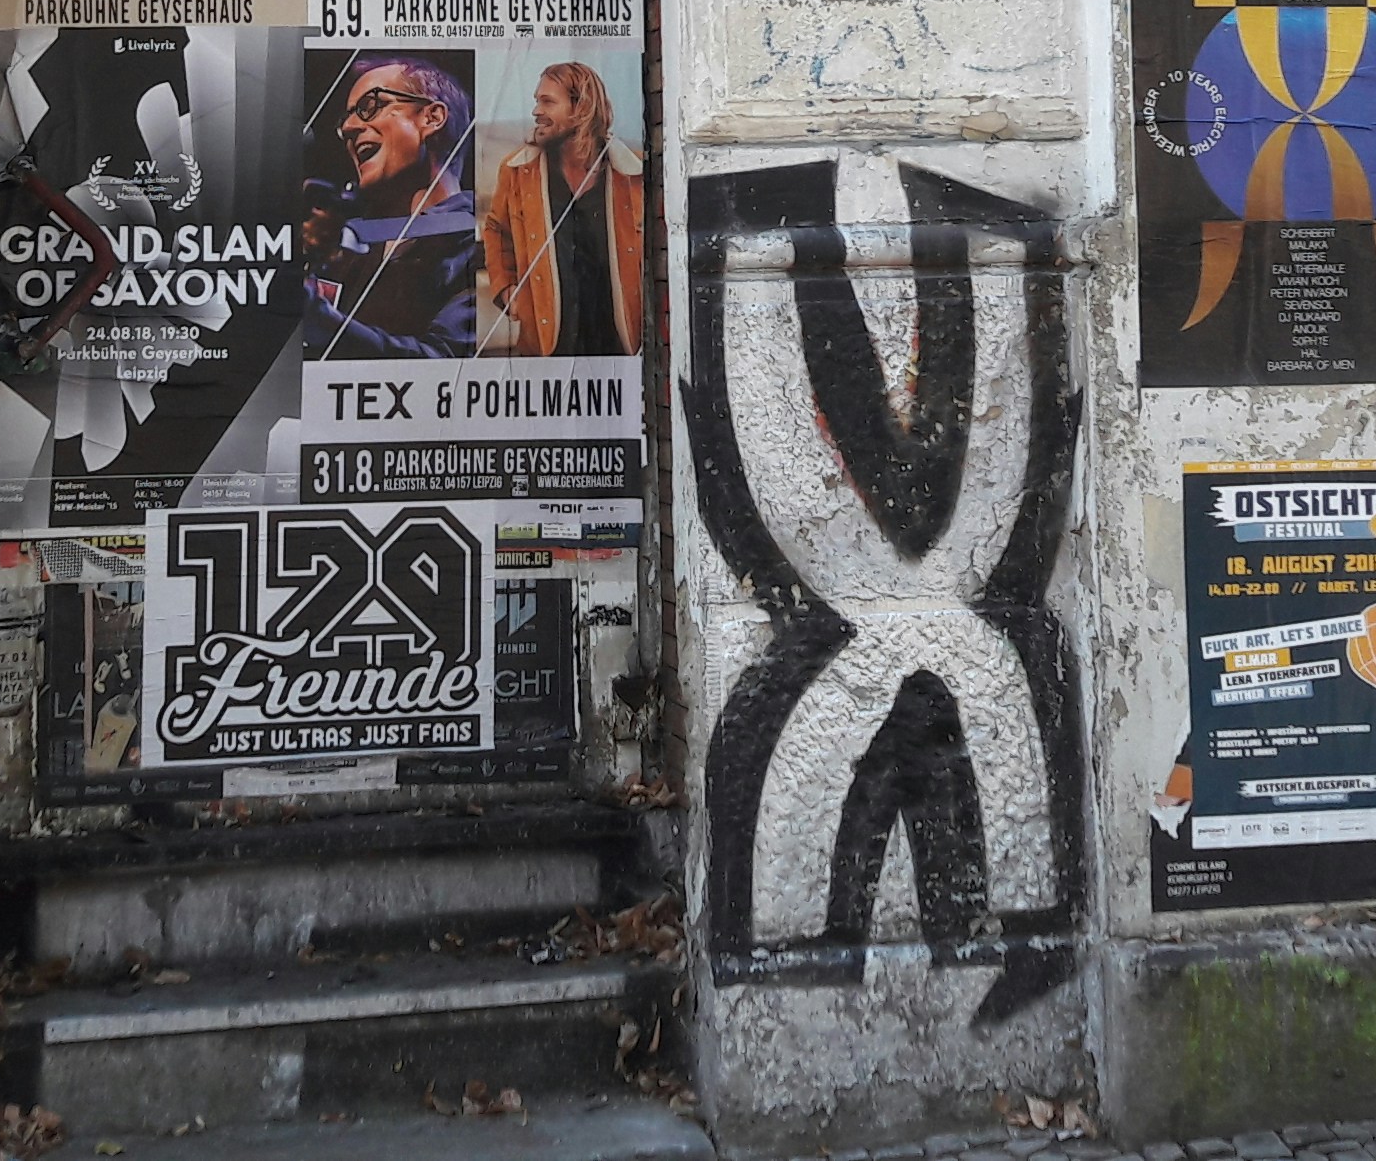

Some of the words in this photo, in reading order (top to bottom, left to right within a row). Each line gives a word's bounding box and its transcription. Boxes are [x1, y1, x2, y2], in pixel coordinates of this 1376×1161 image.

[447, 24, 472, 38] 04157
[475, 24, 505, 38] LEIPZIG
[128, 38, 175, 53] Livelyrix
[135, 160, 160, 175] XV.
[0, 224, 163, 264] GRAND
[178, 224, 292, 264] SLAM
[17, 269, 77, 307] OF
[90, 268, 277, 307] SAXONY
[87, 326, 156, 342] 24.08.18,
[161, 325, 200, 340] 19:30
[142, 345, 228, 363] Geyserhaus
[116, 366, 168, 382] Leipzig
[328, 382, 414, 420] TEX
[437, 382, 452, 419] &
[467, 379, 623, 417] POHLMANN
[313, 449, 379, 494] 31.8.
[384, 445, 496, 477] PARKBÜHNE
[504, 447, 625, 474] GEYSERHAUS
[537, 475, 624, 489] WWW.GEYSERHAUS.DE
[1265, 522, 1344, 538] FESTIVAL
[1227, 556, 1253, 576] 18.
[1262, 554, 1336, 575] AUGUST
[1205, 636, 1239, 655] FUCK
[1246, 631, 1274, 650] ART,
[1280, 626, 1315, 643] LET'S
[1321, 620, 1363, 637] DANCE
[1234, 653, 1278, 668] ELMAR
[1225, 672, 1253, 687] LENA
[1257, 663, 1336, 683] STOEHRFAKTOR
[160, 634, 478, 743] Freunde
[209, 728, 264, 752] JUST
[270, 726, 351, 750] ULTRAS
[358, 723, 413, 746] JUST
[418, 720, 472, 744] FANS
